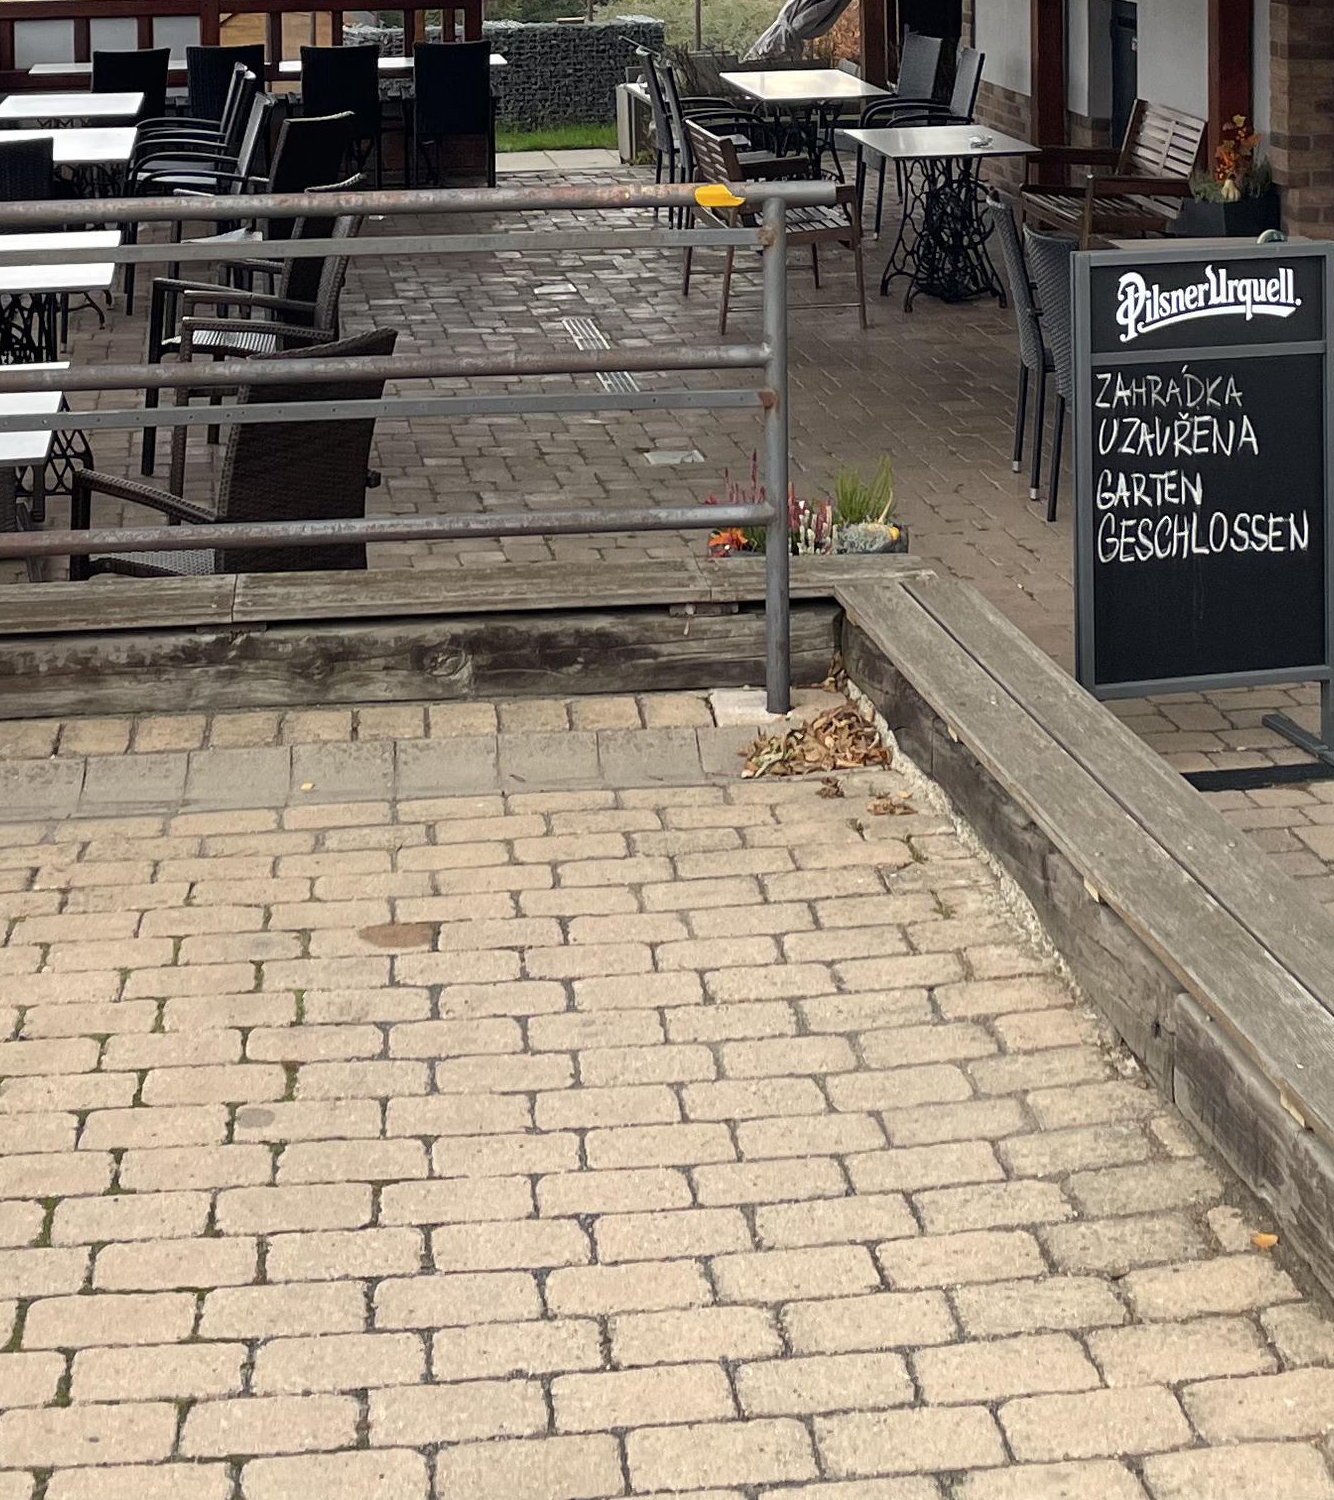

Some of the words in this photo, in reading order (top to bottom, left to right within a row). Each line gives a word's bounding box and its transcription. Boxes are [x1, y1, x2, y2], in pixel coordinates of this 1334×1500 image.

[1115, 271, 1208, 343] Pilsner
[1098, 411, 1259, 457] UZAVŘENA
[1096, 468, 1203, 510] GARTEN
[1097, 509, 1309, 564] GESCHLOSSEN
